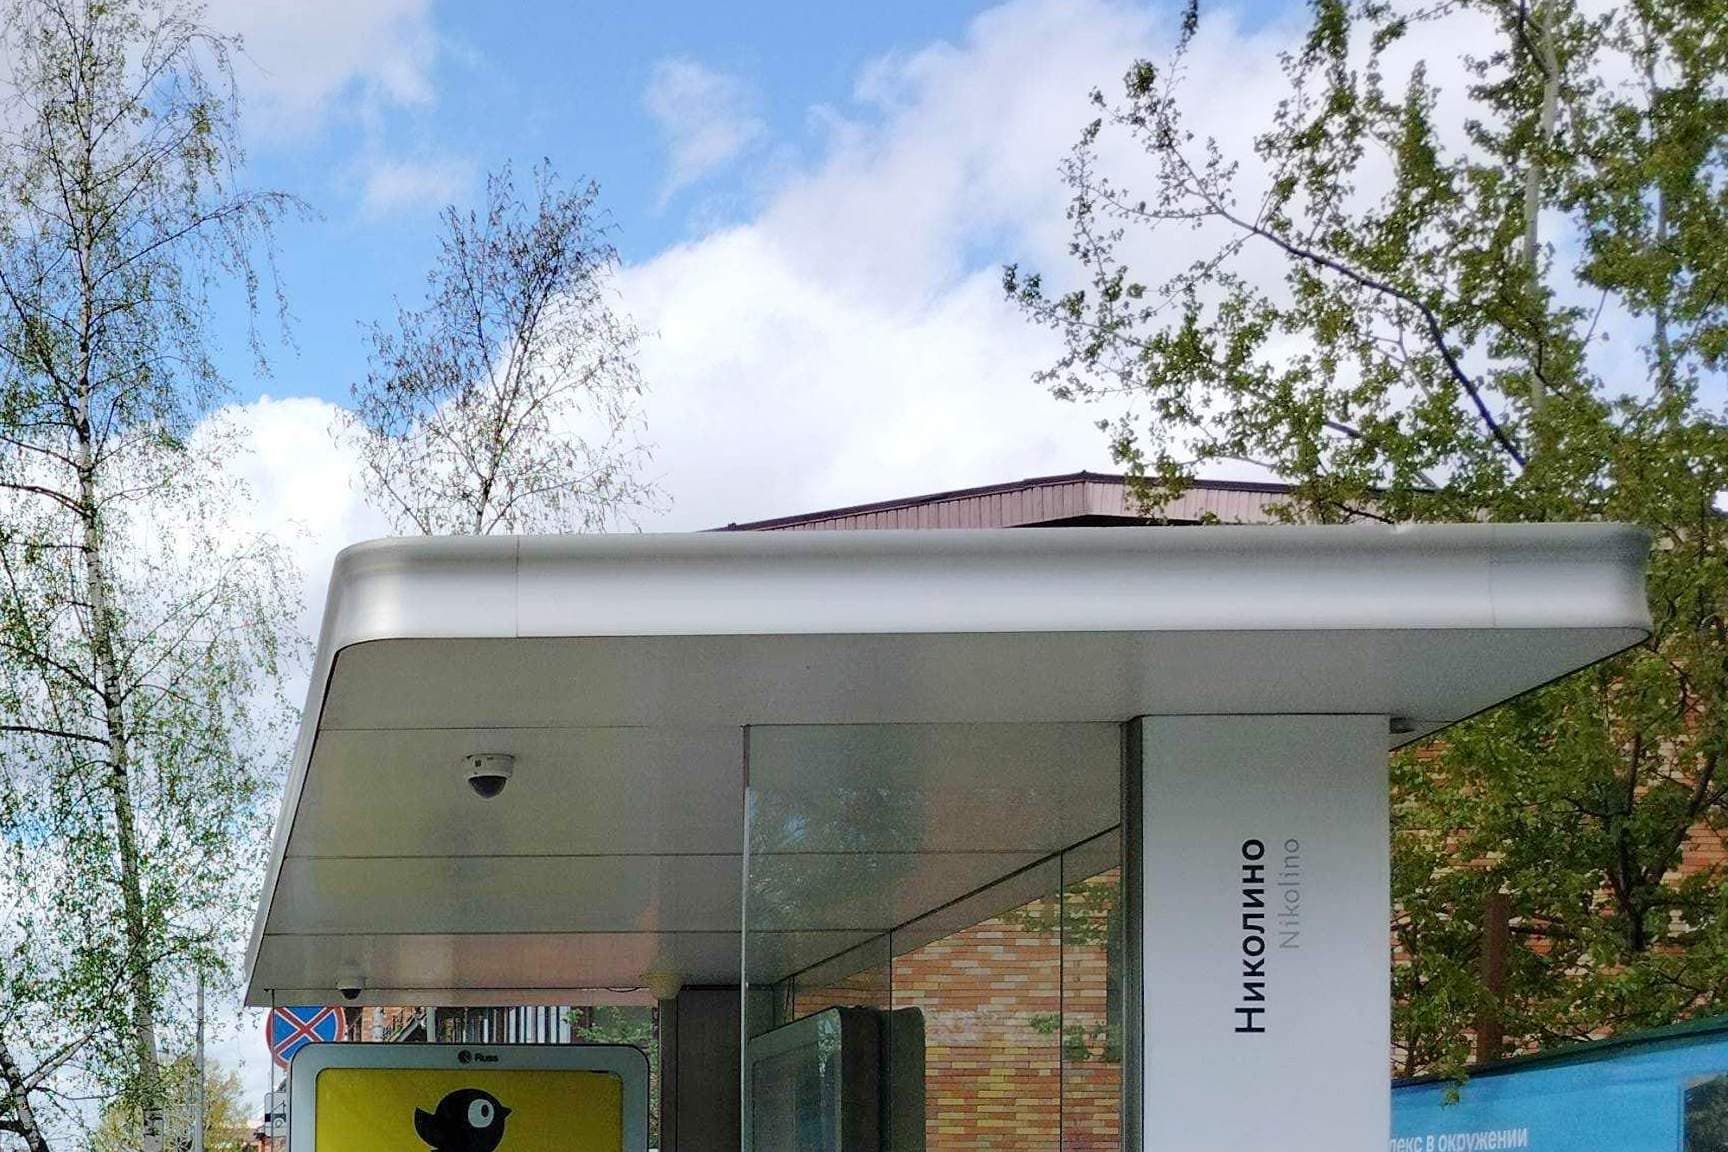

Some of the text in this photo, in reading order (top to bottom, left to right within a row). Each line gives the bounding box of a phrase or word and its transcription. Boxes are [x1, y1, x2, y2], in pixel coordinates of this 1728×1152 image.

[1235, 839, 1265, 1033] Николино
[1277, 838, 1300, 949] Nikolino
[1426, 1135, 1434, 1152] в
